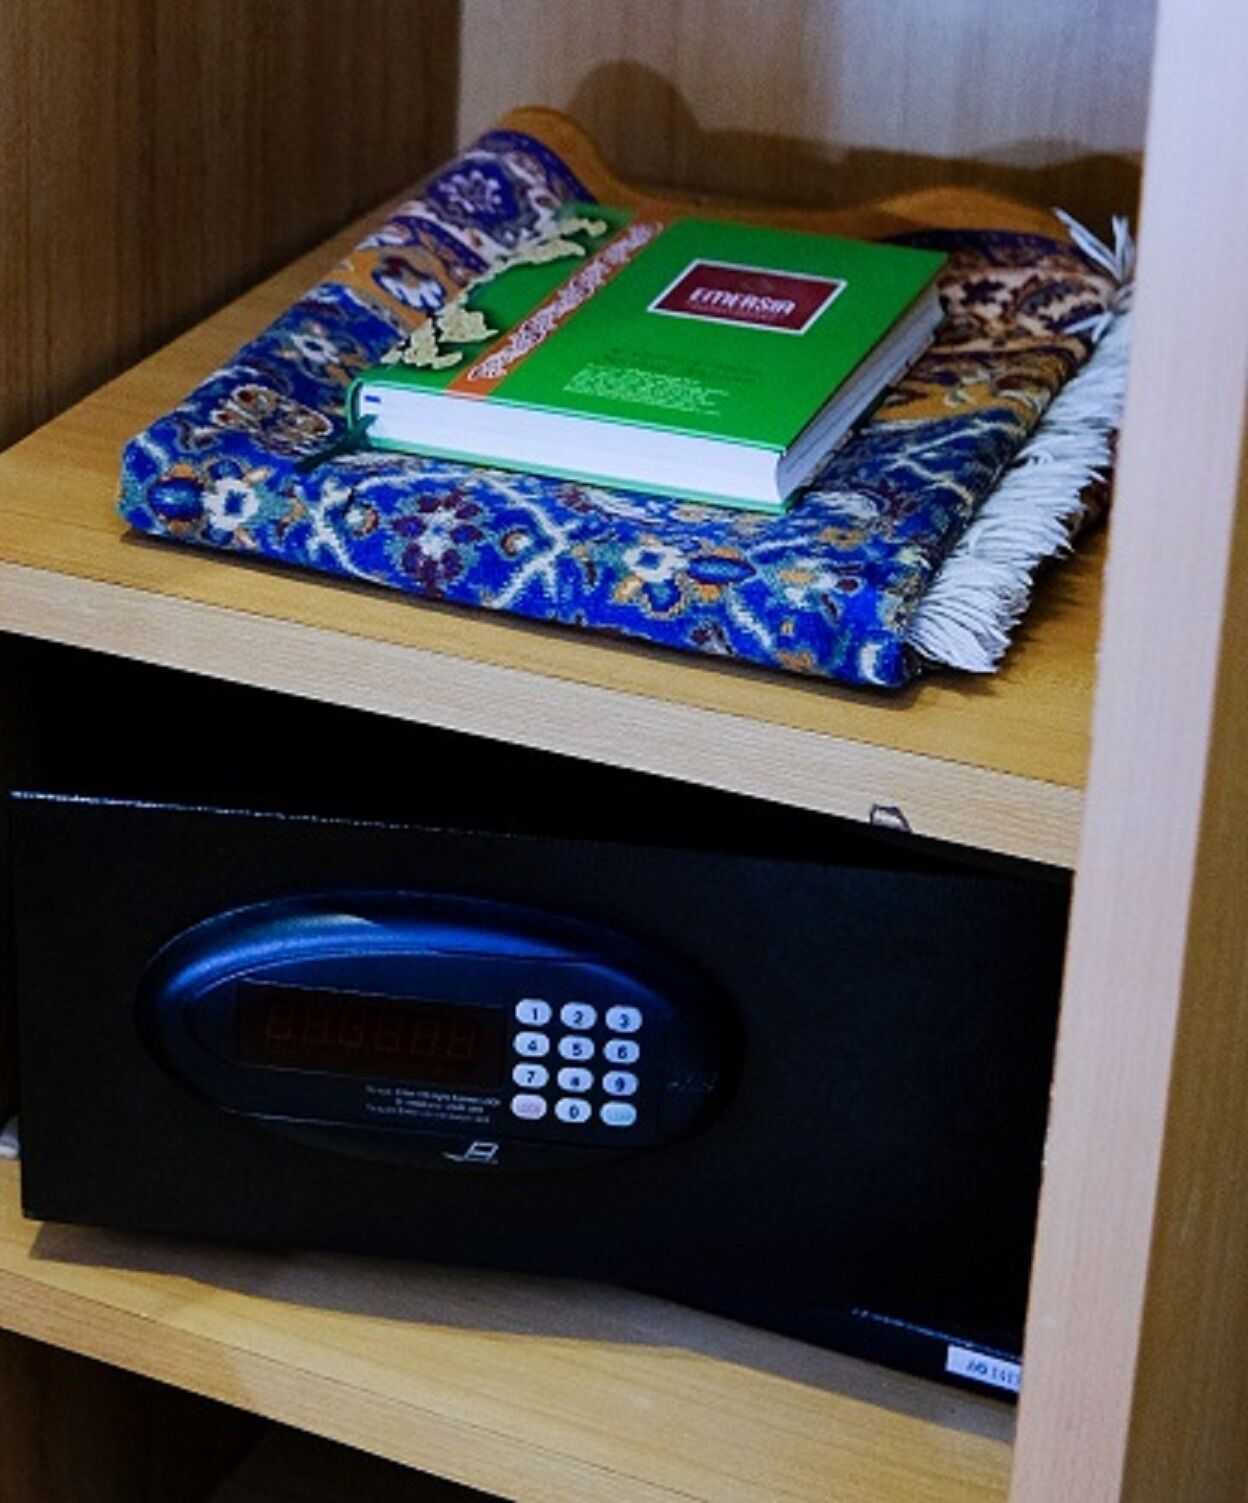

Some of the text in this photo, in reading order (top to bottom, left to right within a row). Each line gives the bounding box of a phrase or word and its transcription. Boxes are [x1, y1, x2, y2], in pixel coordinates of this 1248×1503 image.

[573, 1010, 584, 1024] 2
[619, 1013, 630, 1029] 3
[527, 1040, 628, 1060] 4 5 6
[527, 1070, 536, 1084] 7
[614, 1076, 626, 1092] 9
[569, 1103, 580, 1119] 0
